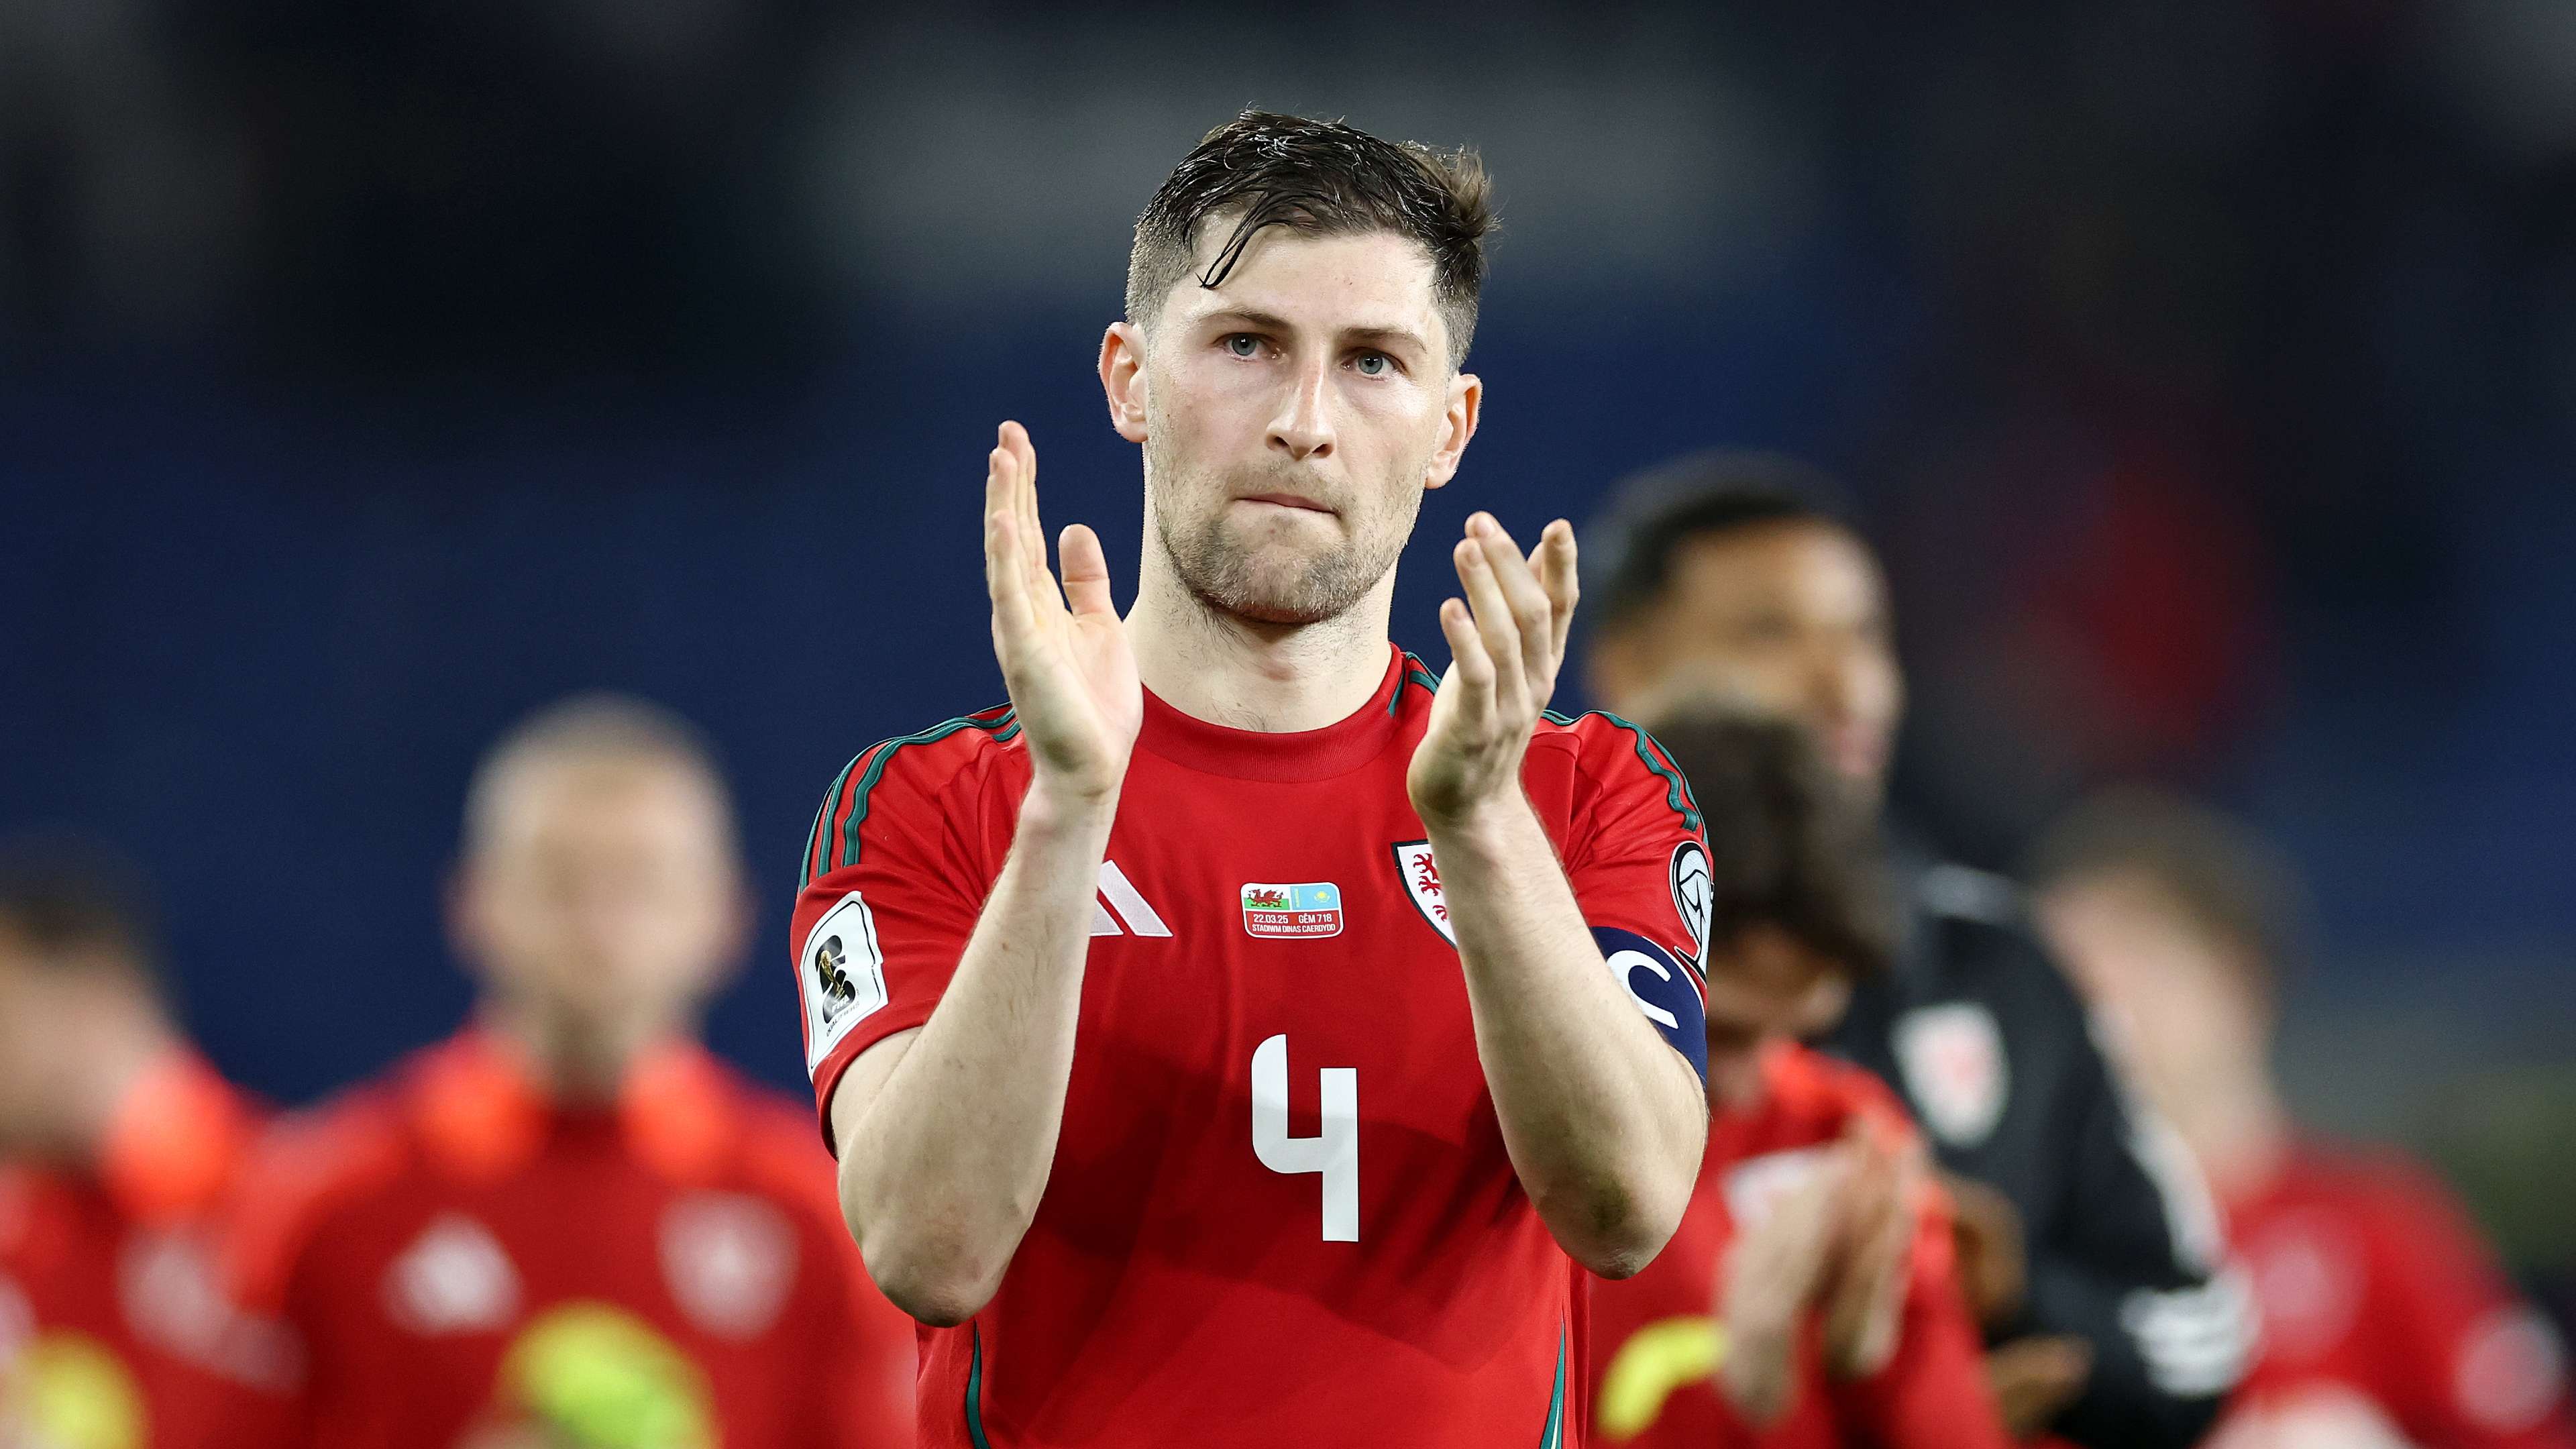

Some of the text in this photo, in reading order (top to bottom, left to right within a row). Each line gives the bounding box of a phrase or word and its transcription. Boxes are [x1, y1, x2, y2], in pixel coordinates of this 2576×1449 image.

[1253, 912, 1332, 924] 22.03.25 GÊM 718
[1252, 924, 1336, 933] STADIWM DINAS CAERDYDD
[1606, 950, 1678, 1029] C
[832, 994, 850, 1013] FIFA
[1251, 1034, 1359, 1242] 4
